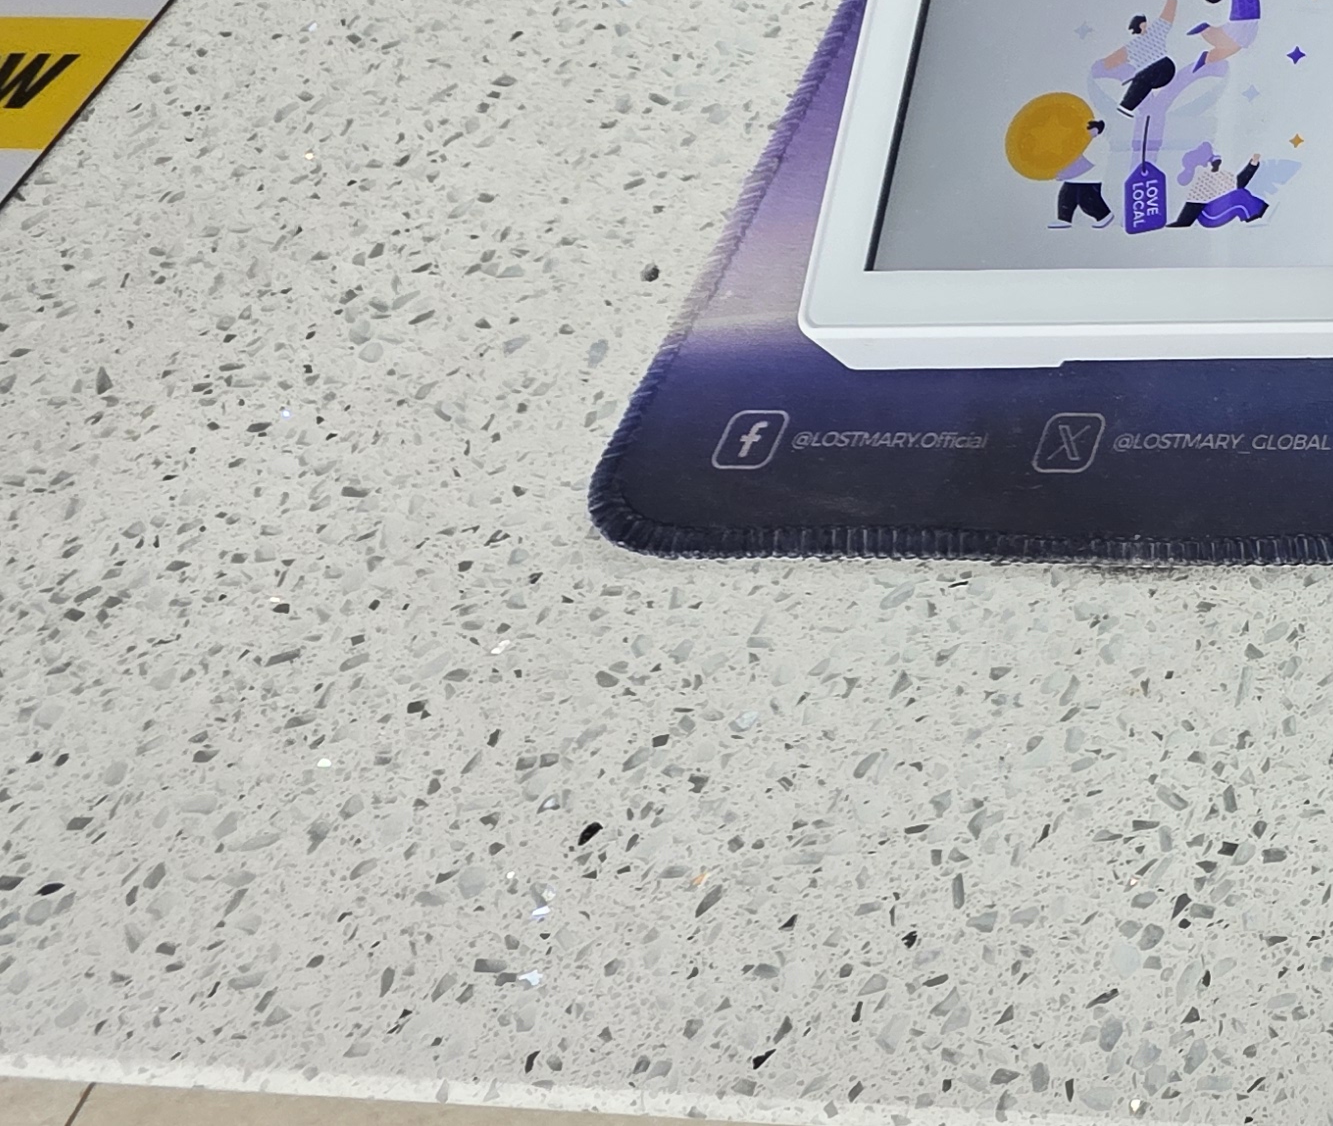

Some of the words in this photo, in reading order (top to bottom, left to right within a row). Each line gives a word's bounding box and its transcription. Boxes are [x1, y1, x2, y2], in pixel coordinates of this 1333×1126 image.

[1131, 182, 1145, 229] LOCAL
[1144, 179, 1160, 217] LOVE
[1112, 433, 1332, 454] @LOSTMARY_GLOBAL
